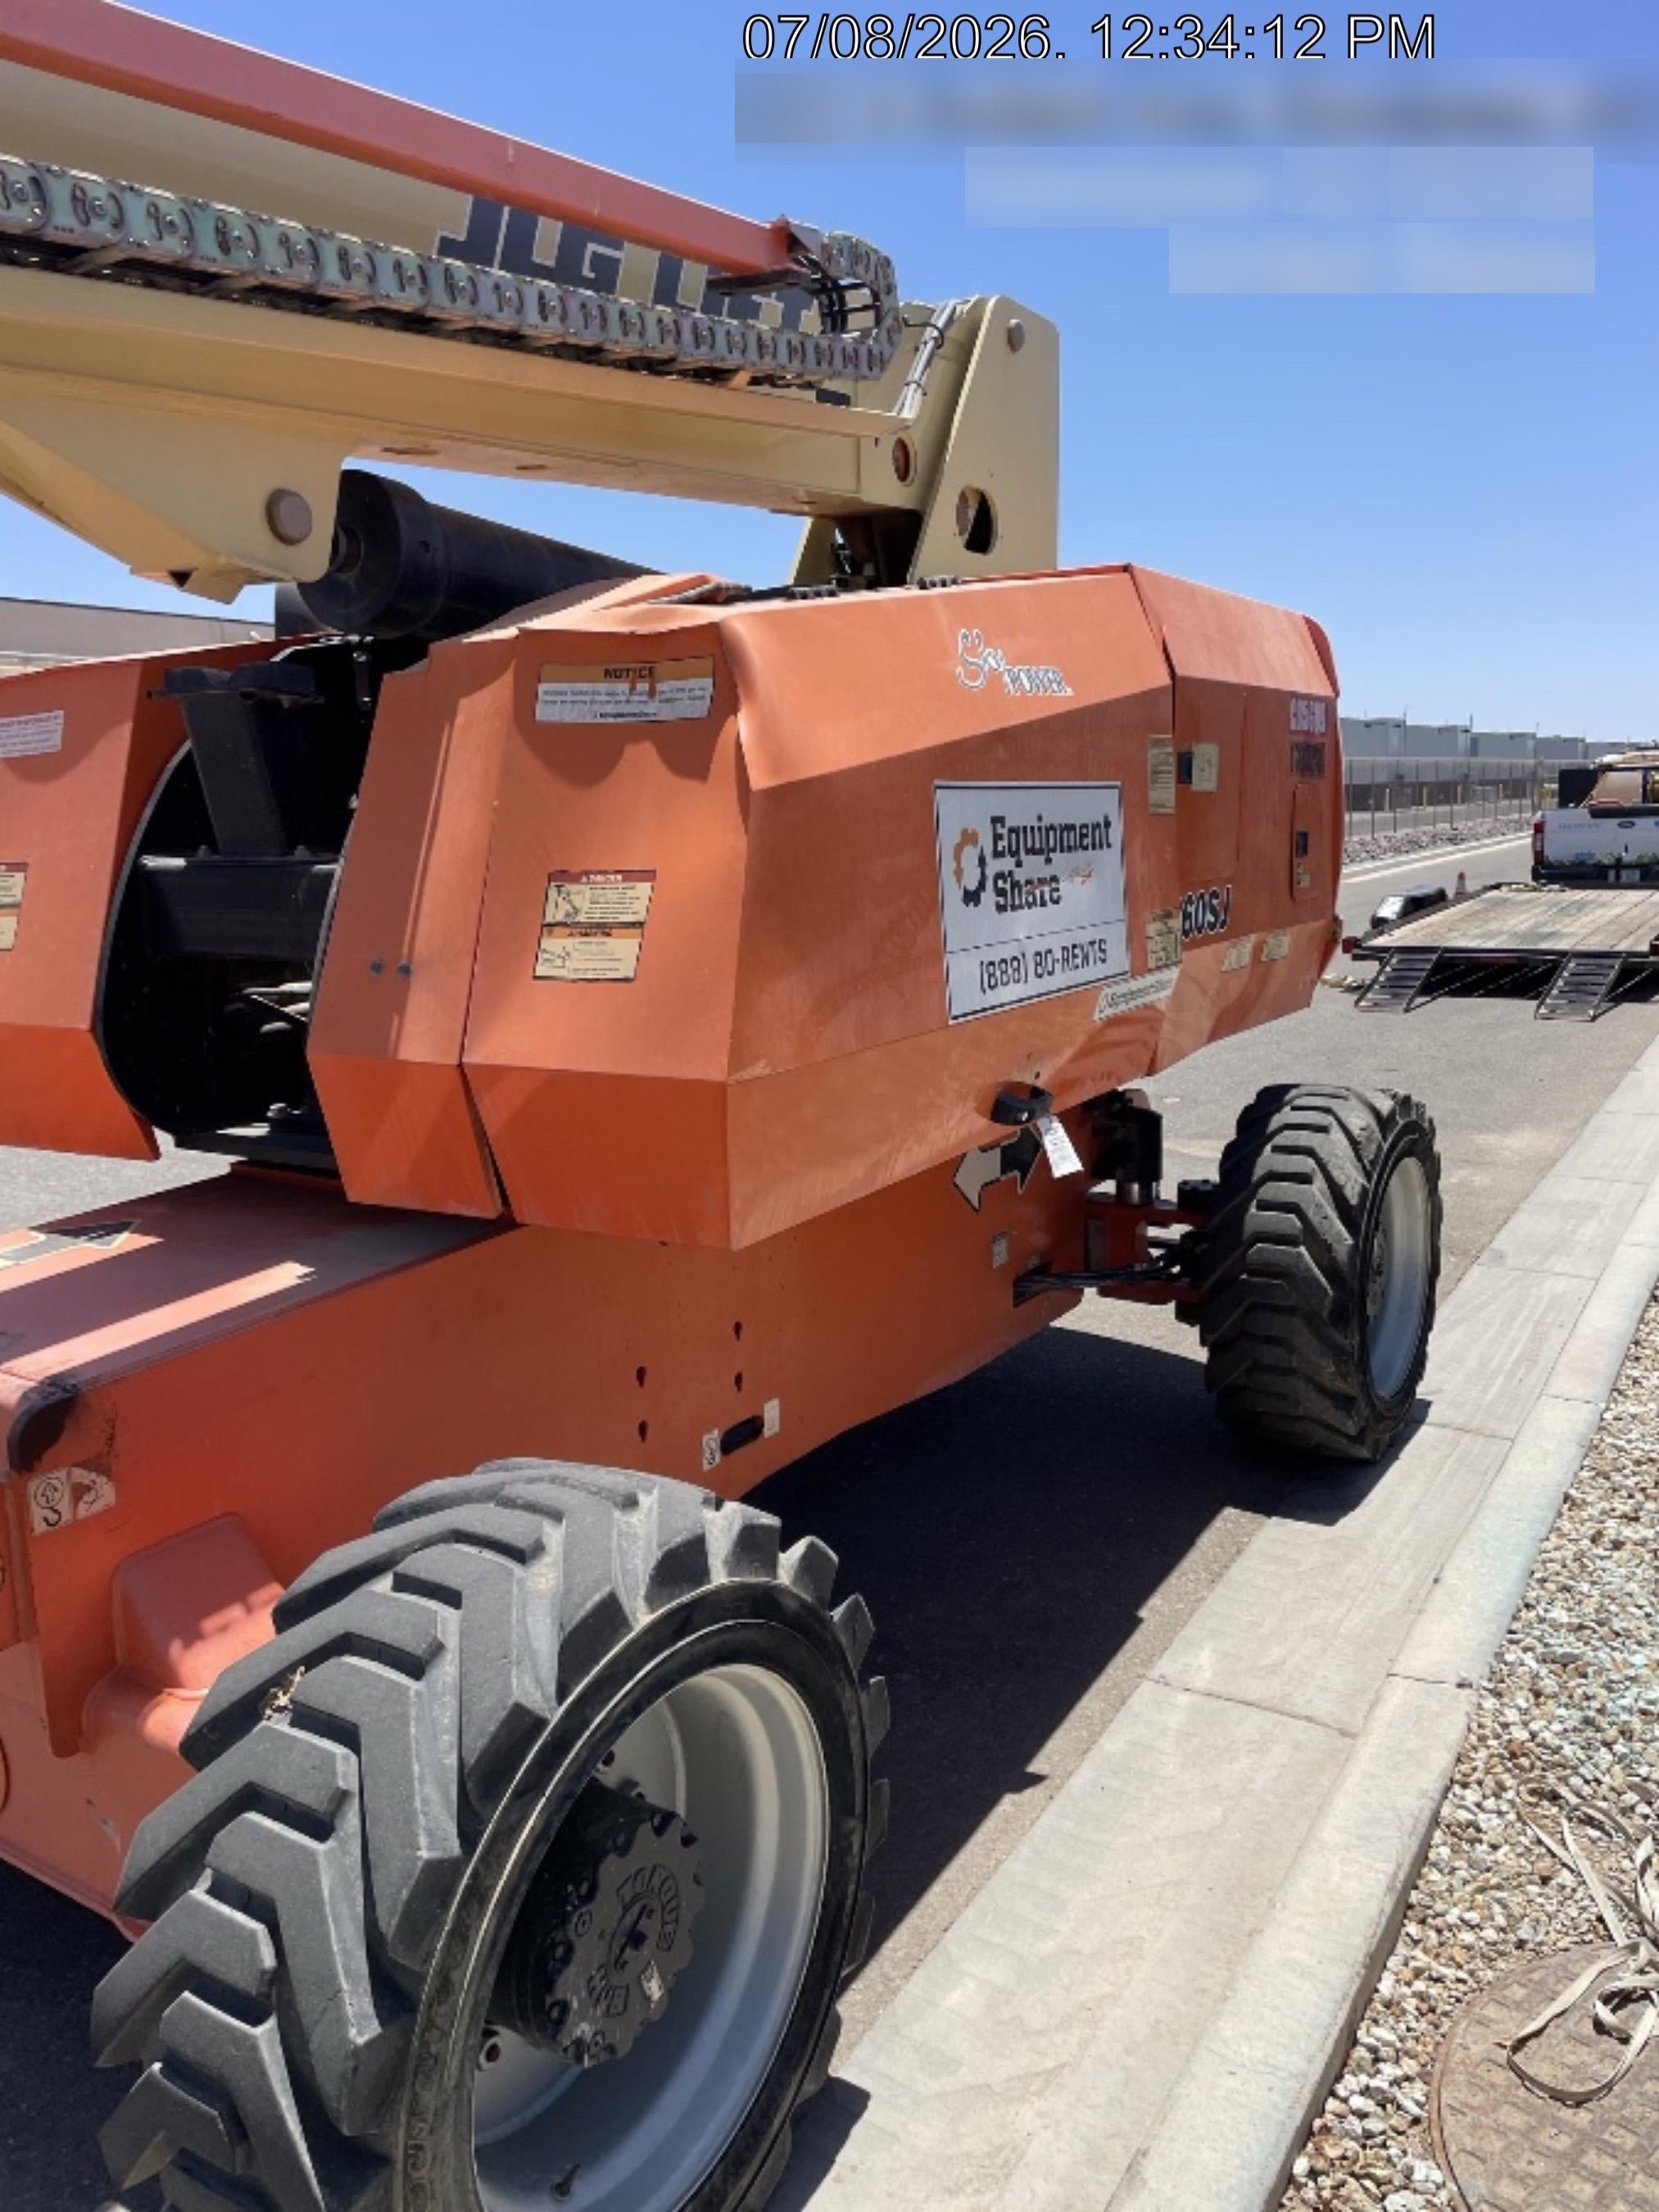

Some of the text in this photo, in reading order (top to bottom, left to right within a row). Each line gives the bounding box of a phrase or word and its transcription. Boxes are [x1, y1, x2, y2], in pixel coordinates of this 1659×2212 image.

[433, 195, 628, 297] JLG
[990, 813, 1112, 868] Equipment
[993, 870, 1063, 914] Share
[1180, 883, 1233, 942] 60SJ
[979, 950, 1029, 995] (888)
